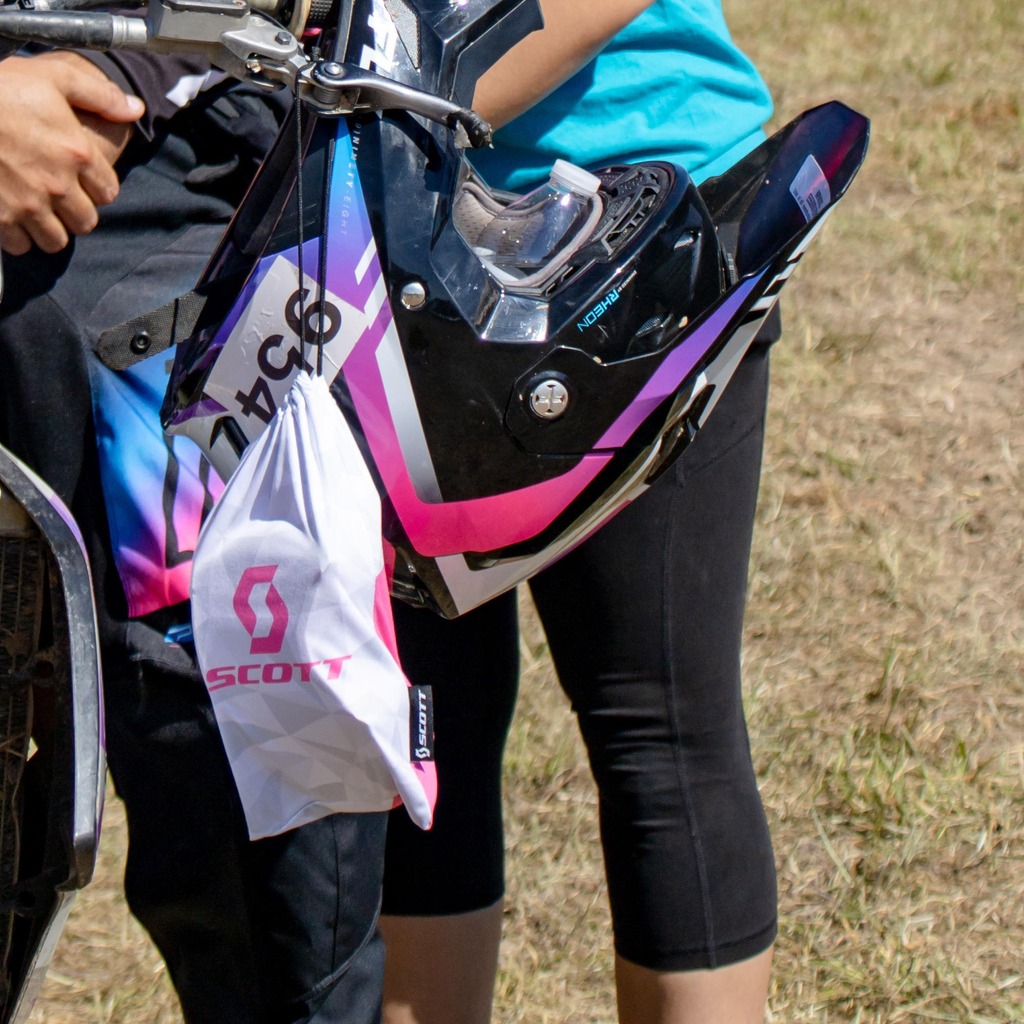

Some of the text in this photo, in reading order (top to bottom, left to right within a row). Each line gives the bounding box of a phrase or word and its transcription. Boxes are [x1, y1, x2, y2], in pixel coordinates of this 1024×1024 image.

[577, 288, 620, 332] RHEON
[234, 288, 342, 425] 954
[206, 655, 352, 693] SCOTT
[418, 689, 427, 746] SCOTT
